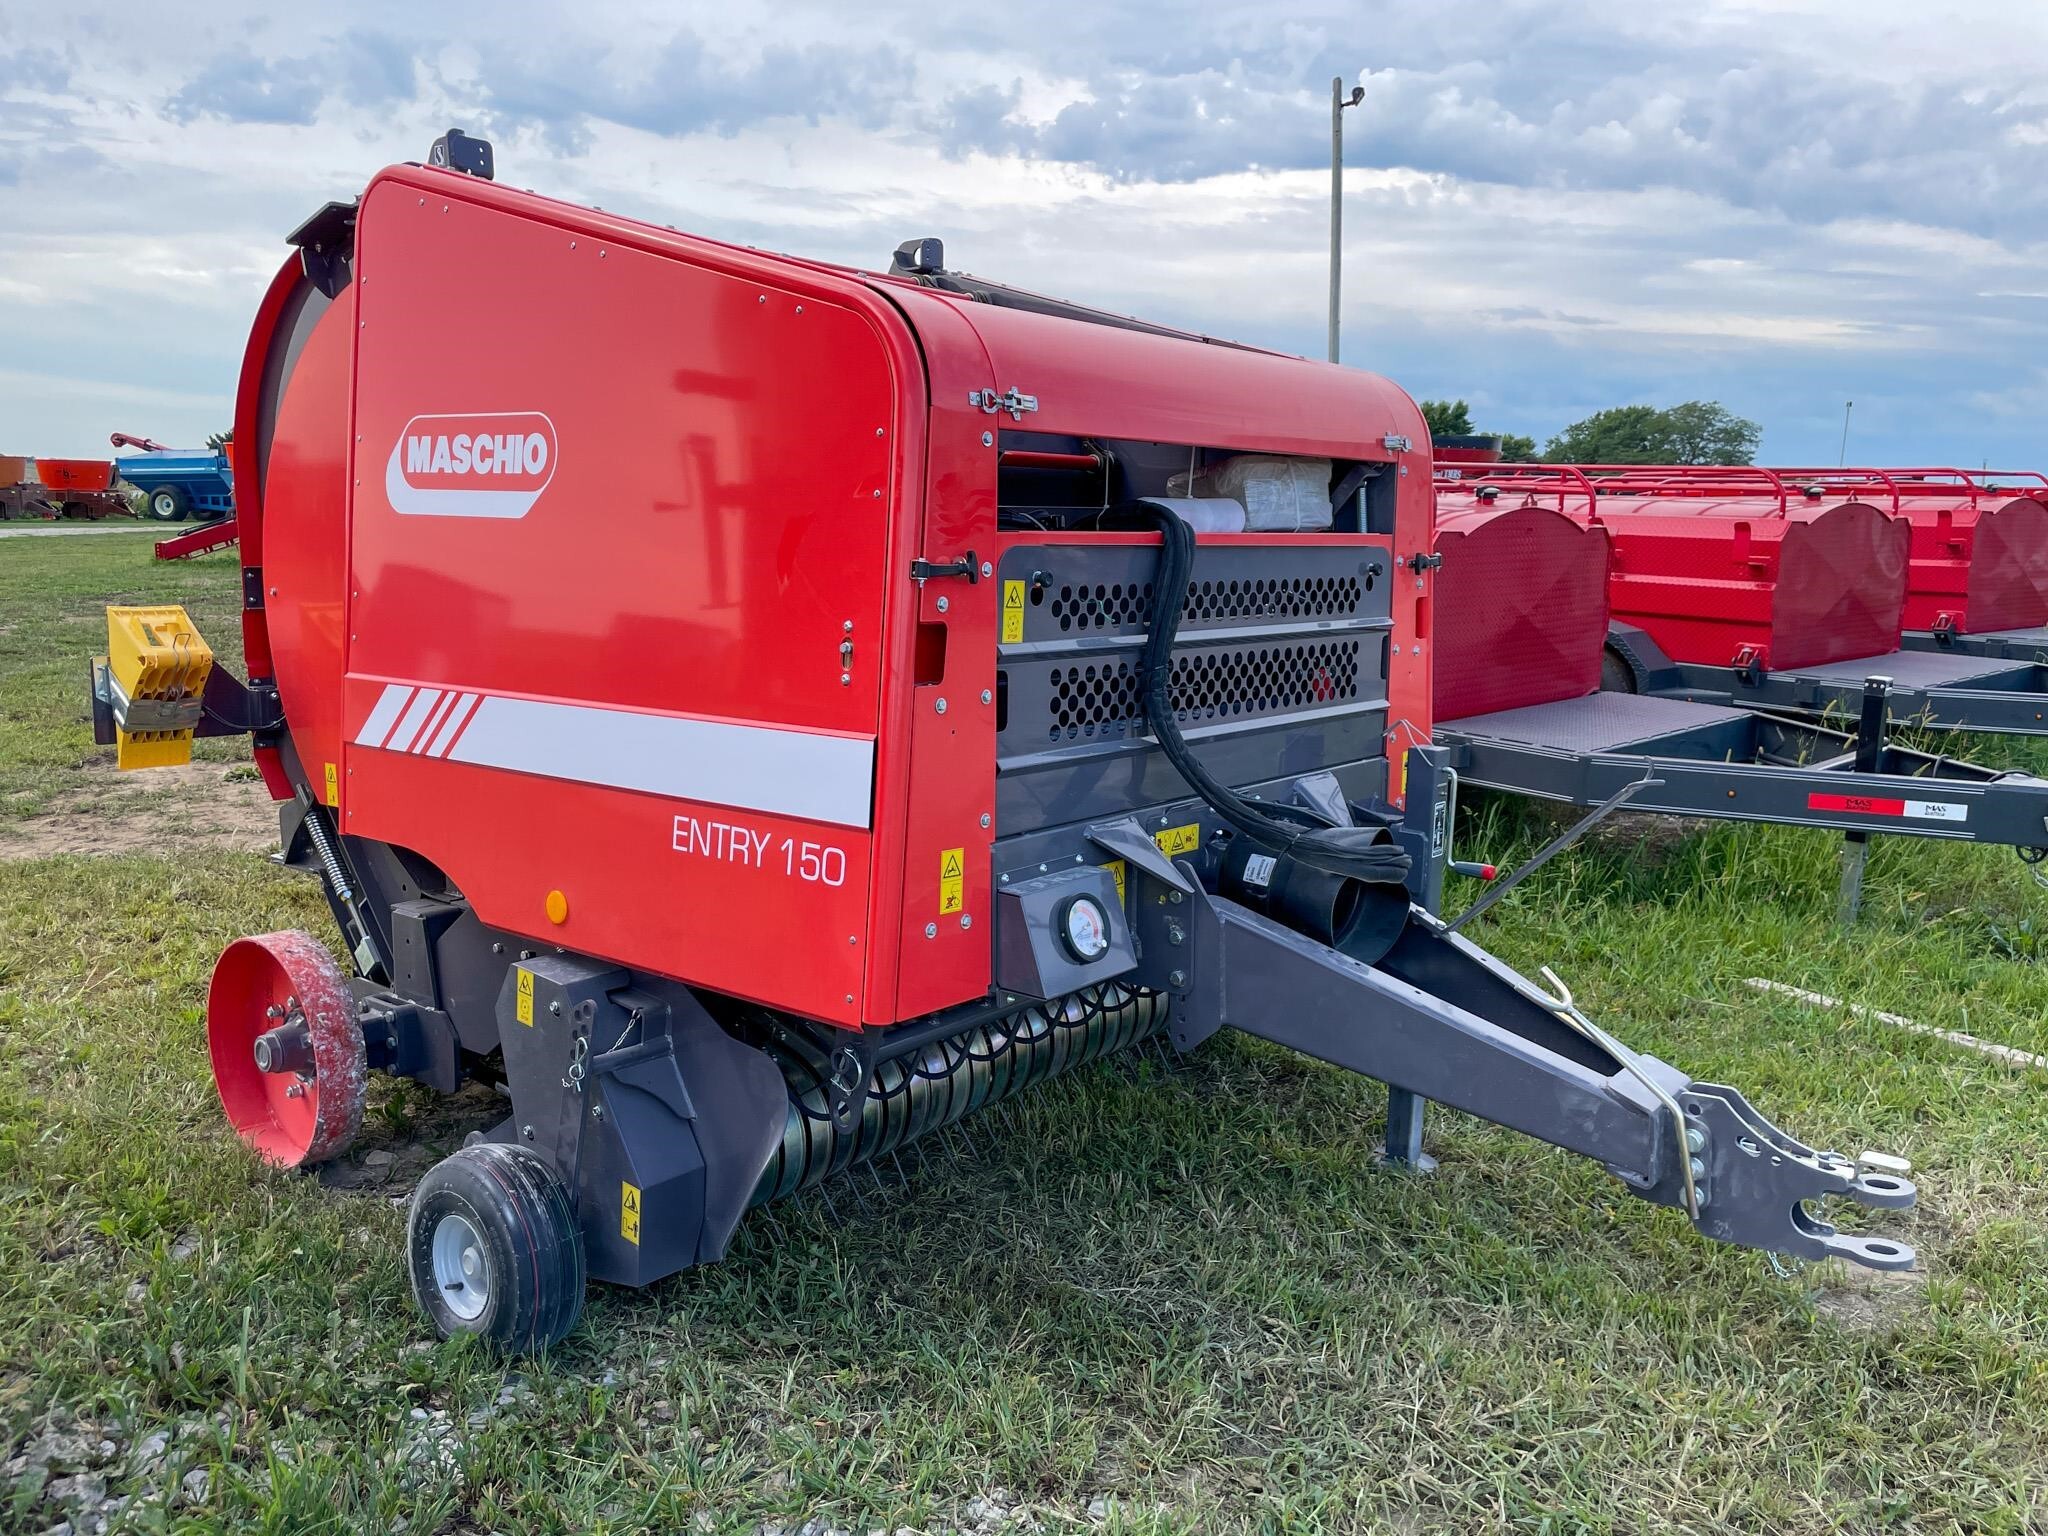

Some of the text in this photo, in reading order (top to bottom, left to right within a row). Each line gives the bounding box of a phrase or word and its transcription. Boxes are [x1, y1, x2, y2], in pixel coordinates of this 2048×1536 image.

[407, 433, 548, 475] MASCHIO
[672, 815, 846, 886] ENTRY 150
